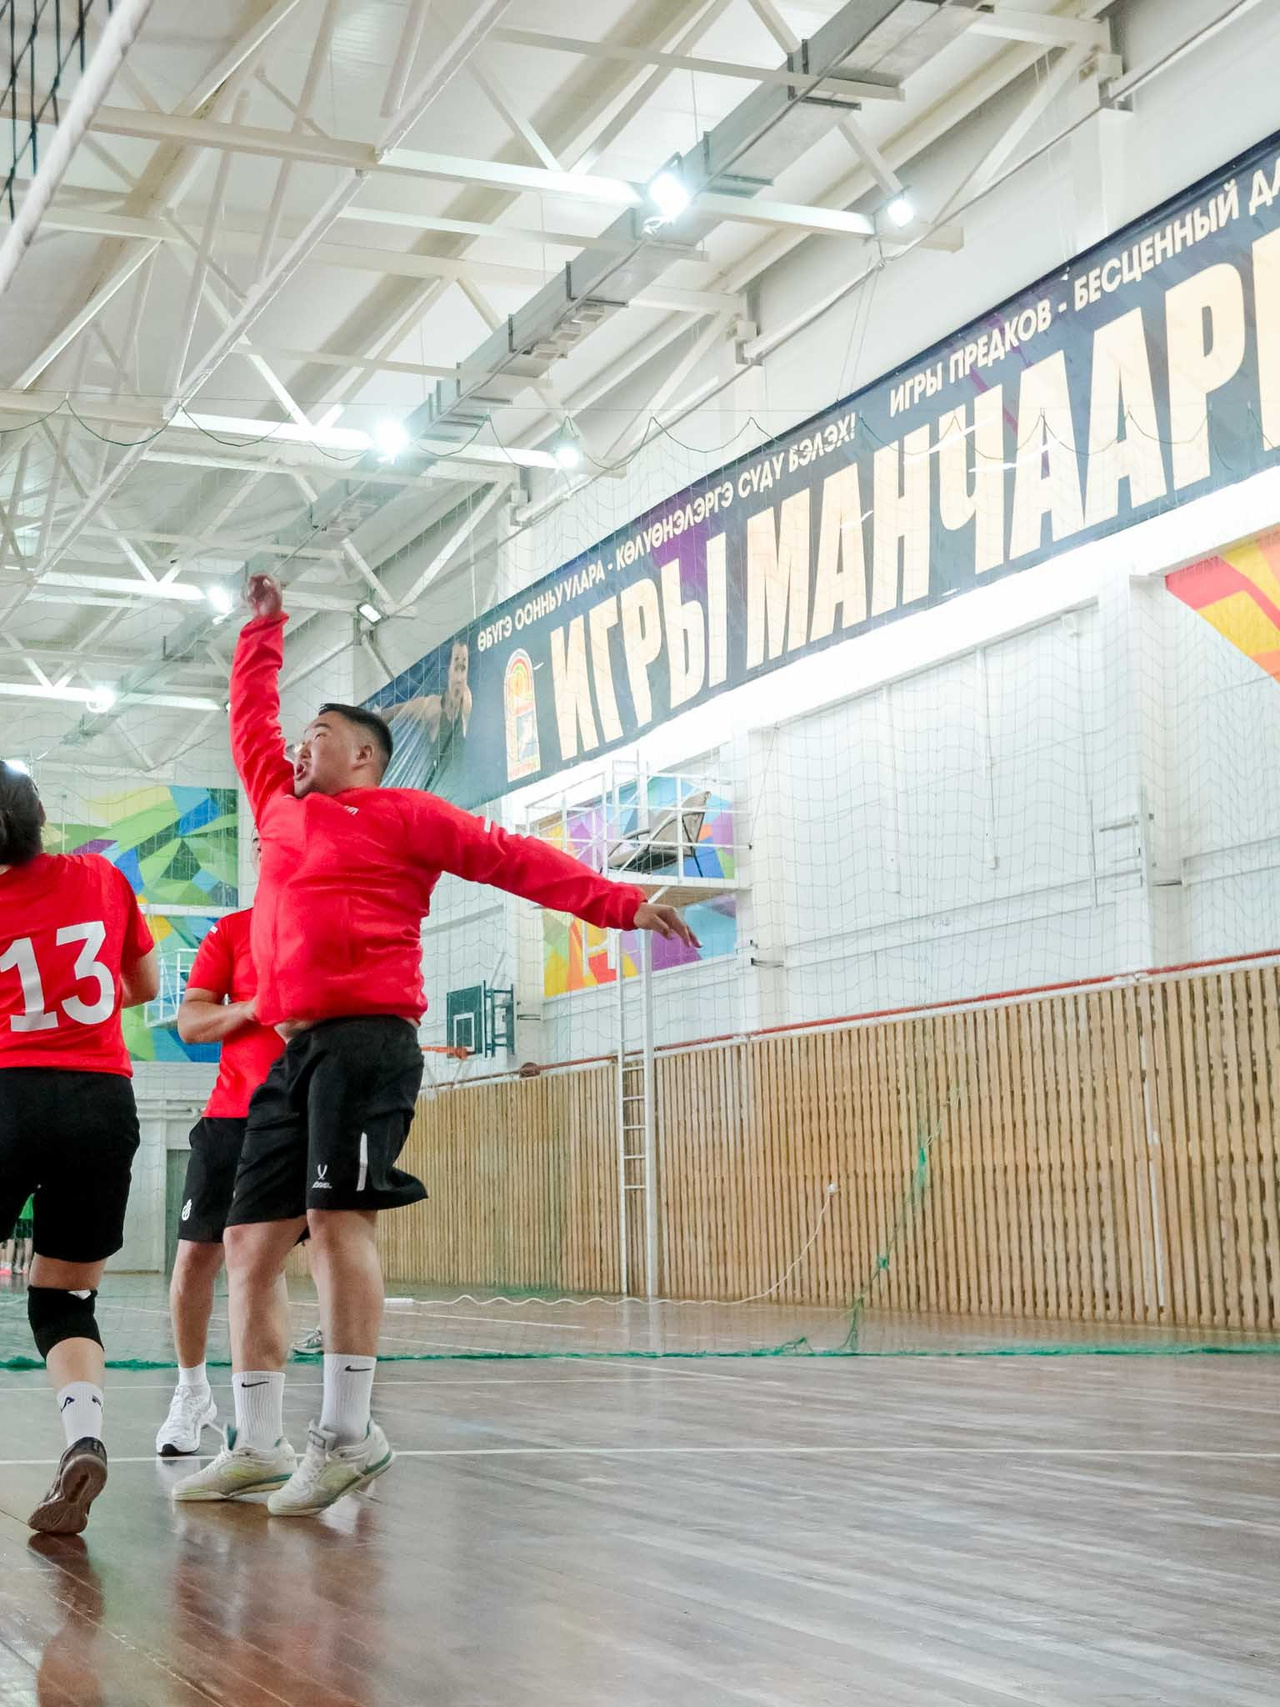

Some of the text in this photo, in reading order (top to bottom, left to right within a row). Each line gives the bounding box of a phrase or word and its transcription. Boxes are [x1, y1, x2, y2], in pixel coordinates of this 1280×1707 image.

[889, 361, 943, 418] ИГРЫ
[949, 298, 1052, 384] ПРЕДКОВ
[1073, 177, 1240, 312] БЕСЦЕННЫЙ
[514, 559, 607, 631] ООННЬУУЛАРА
[788, 411, 857, 474] БЭЛЭХ!
[549, 531, 727, 761] ИГРЫ
